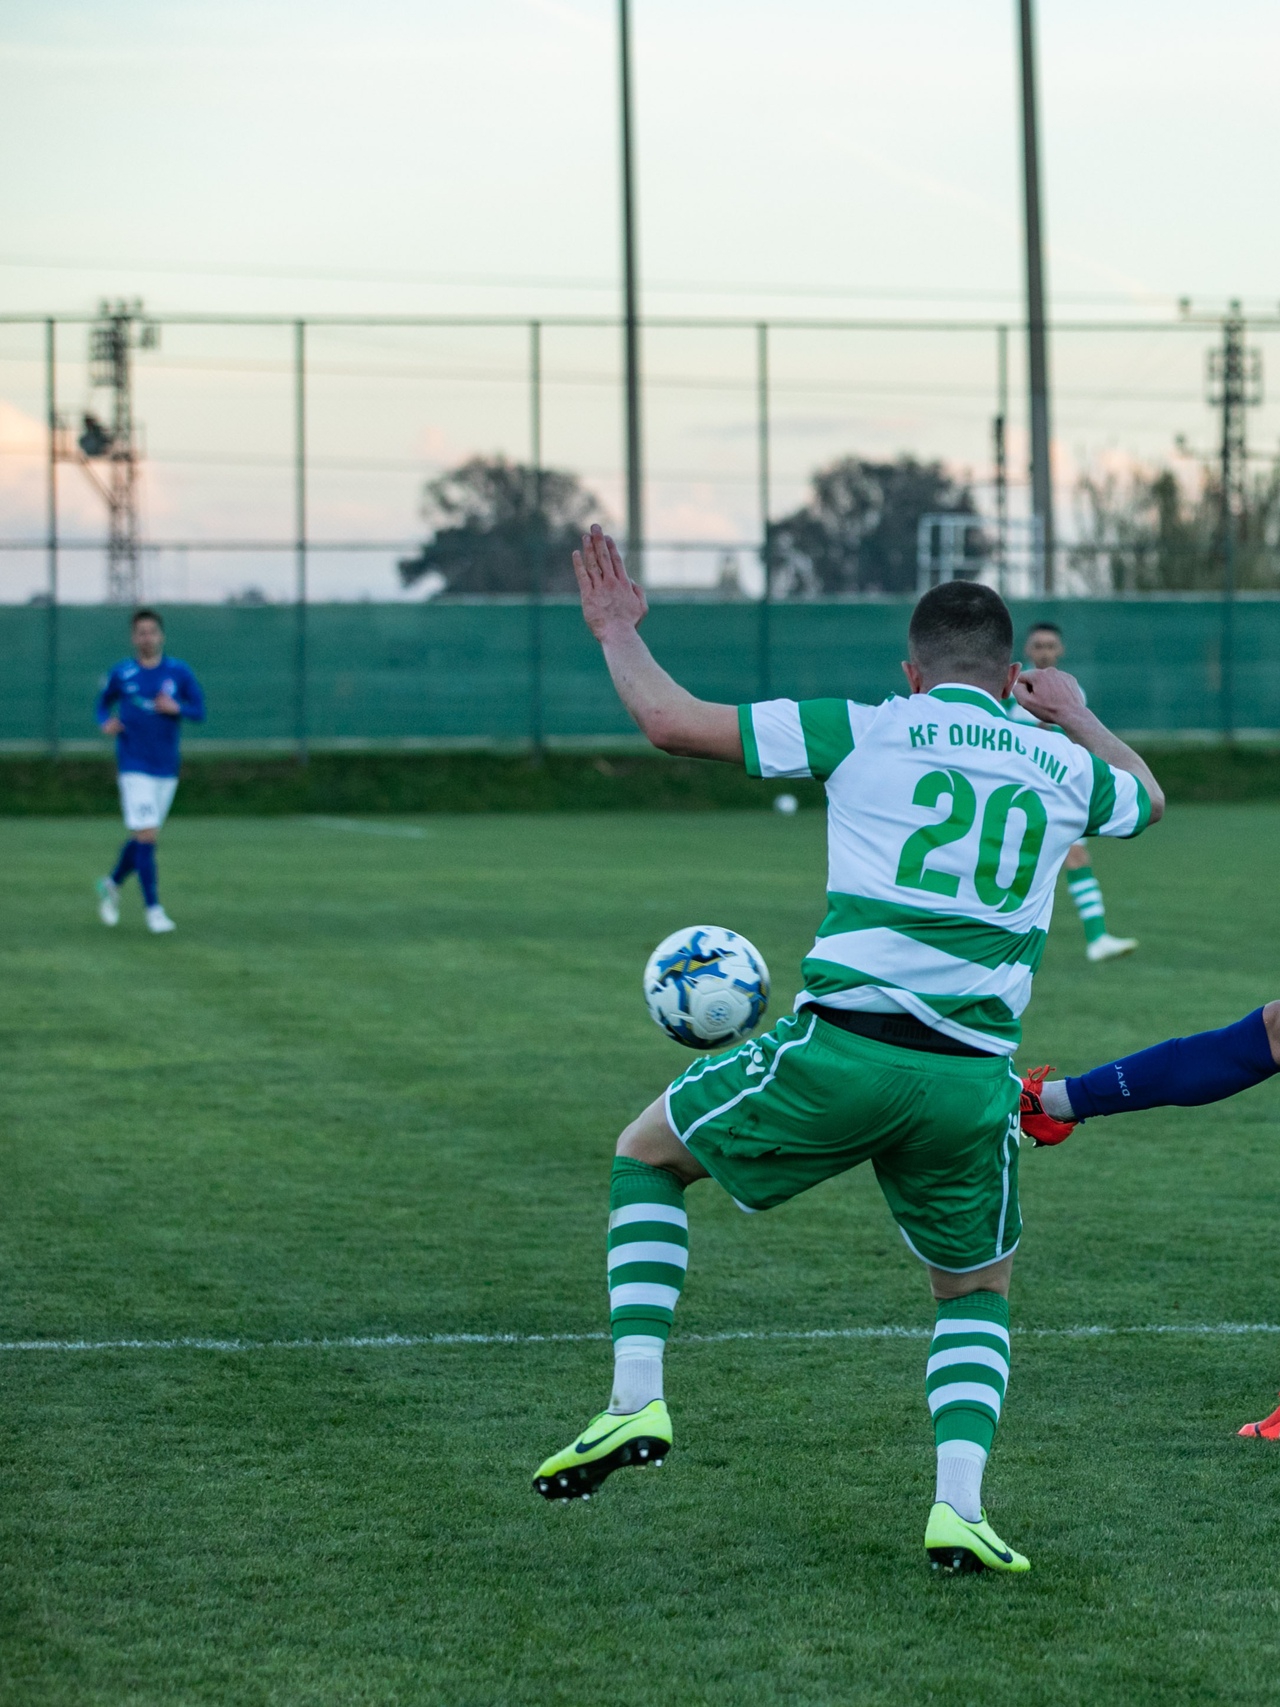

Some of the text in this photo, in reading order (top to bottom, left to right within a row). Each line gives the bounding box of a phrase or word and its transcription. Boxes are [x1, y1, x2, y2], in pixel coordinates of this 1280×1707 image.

[908, 723, 949, 748] KF
[894, 768, 1048, 913] 20
[1114, 1064, 1131, 1097] JAKO
